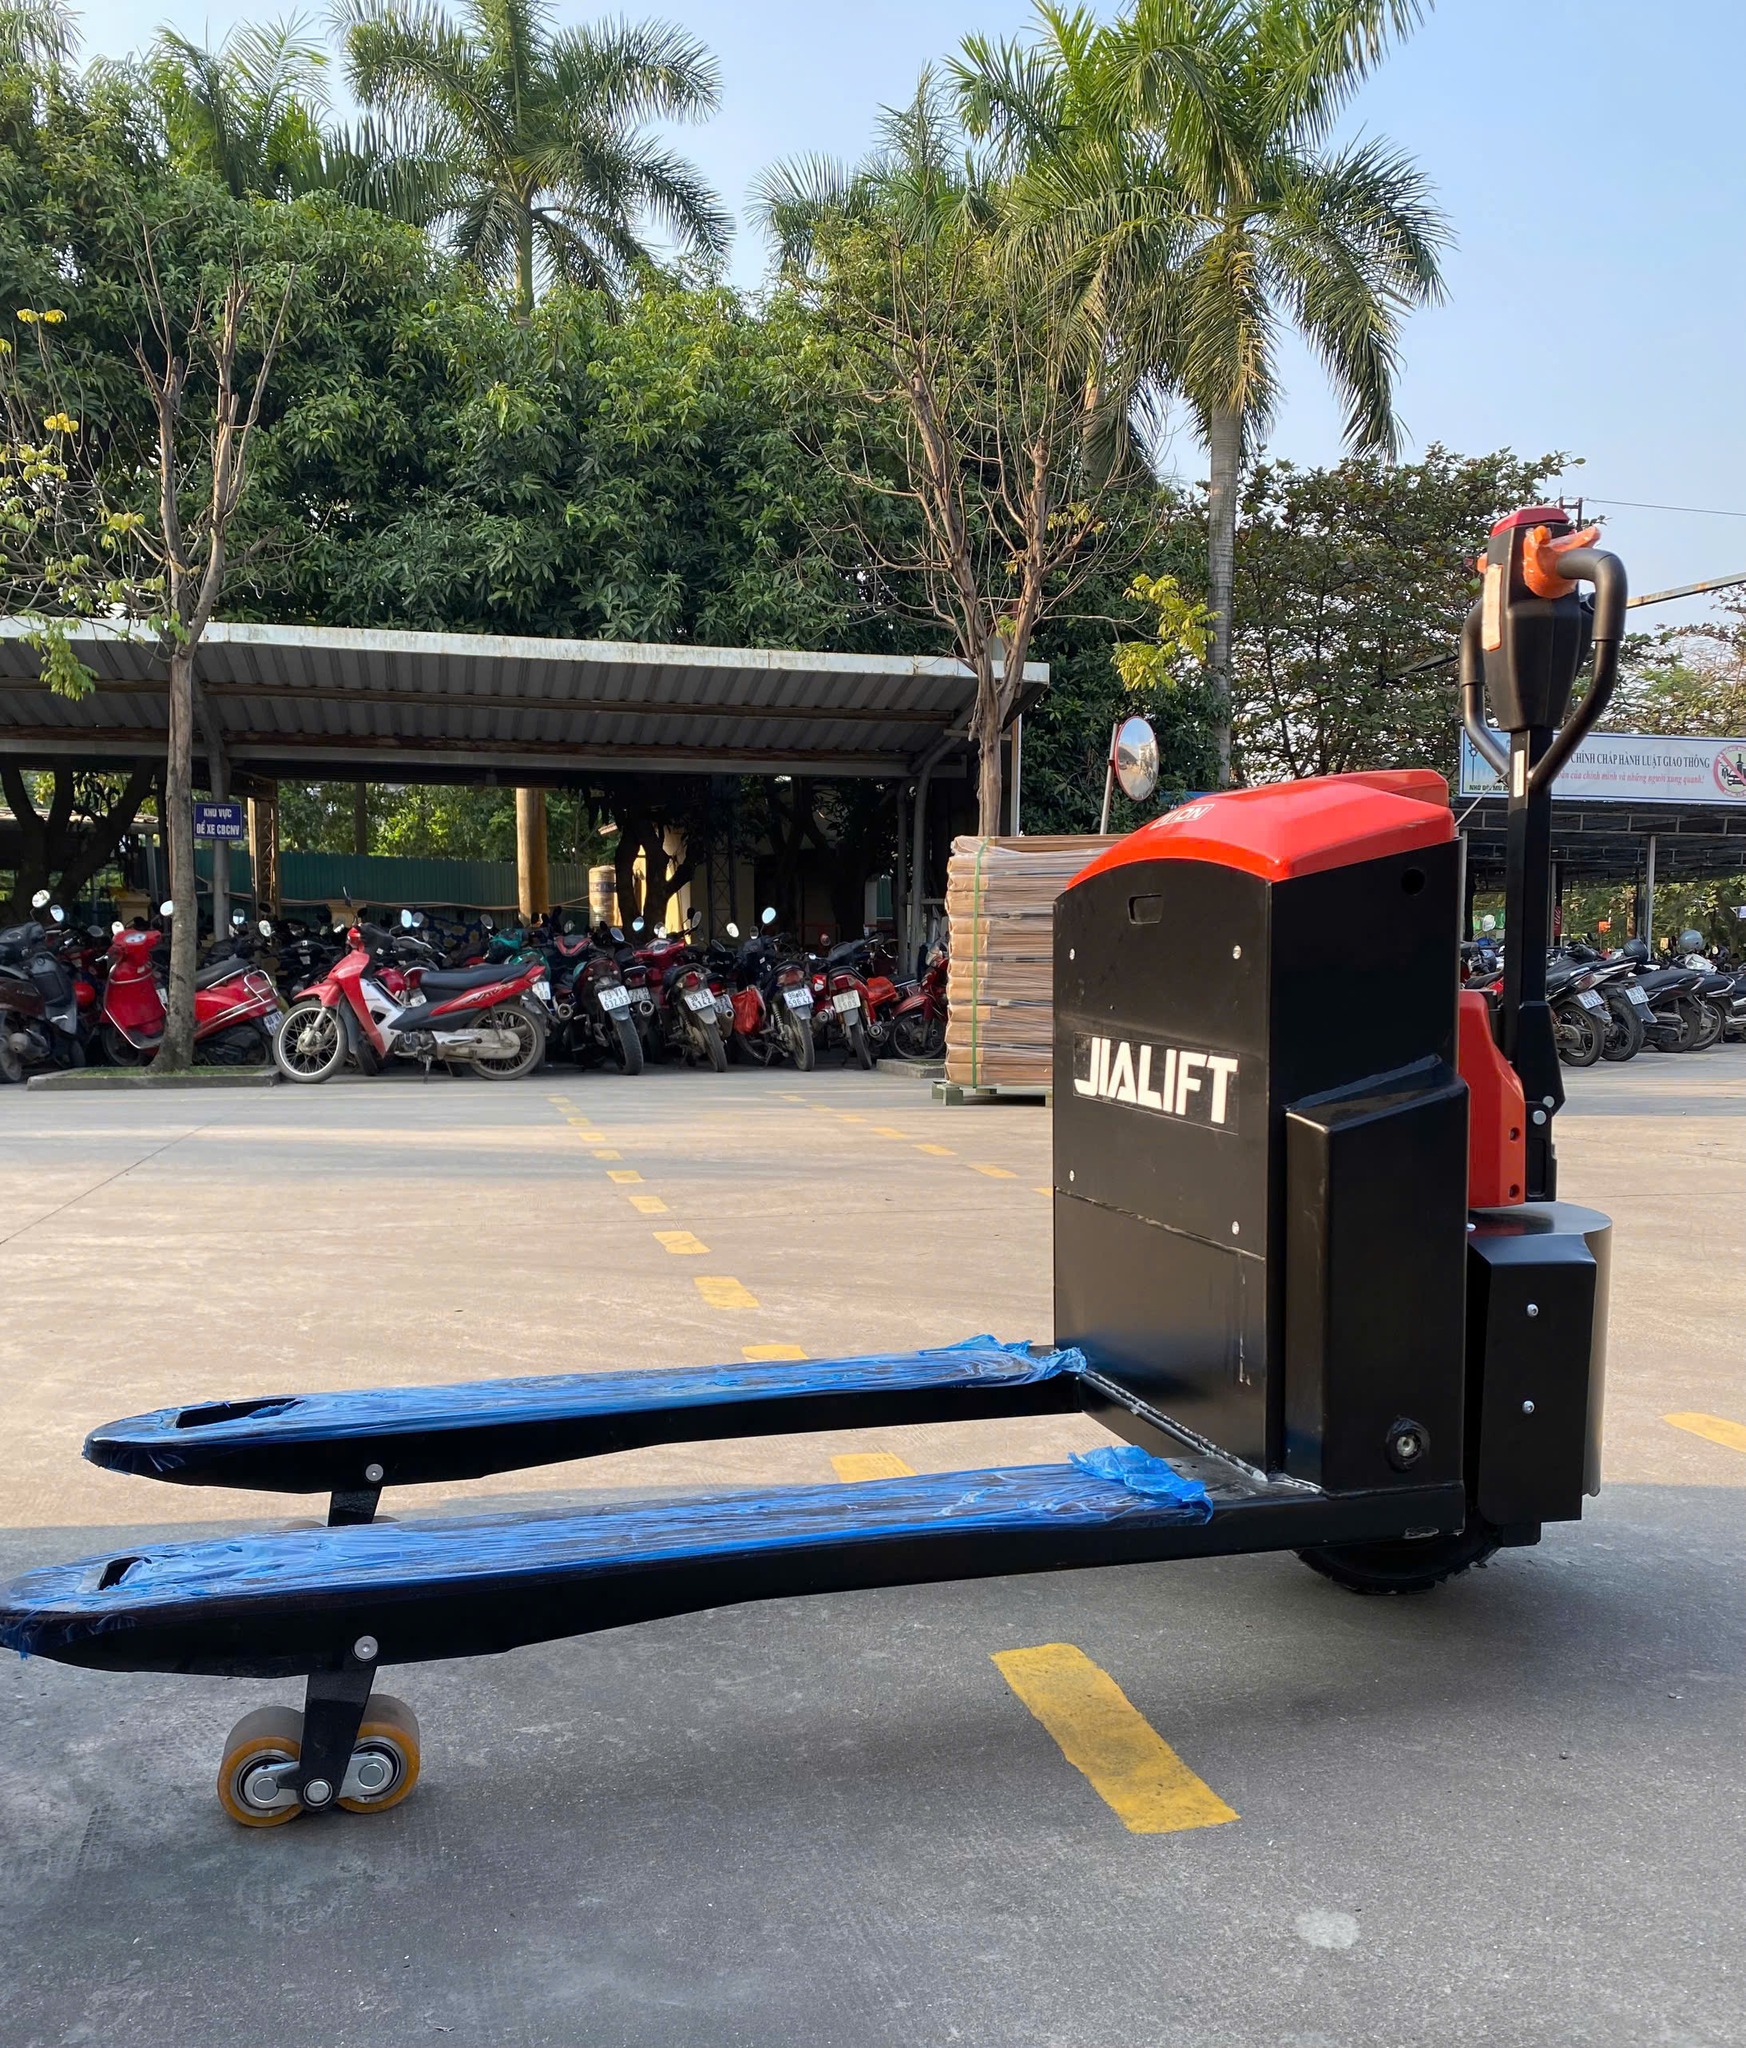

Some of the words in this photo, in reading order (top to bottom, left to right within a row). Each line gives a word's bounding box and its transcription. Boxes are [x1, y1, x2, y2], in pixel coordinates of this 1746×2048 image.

[1663, 756, 1683, 768] GIAO
[203, 808, 217, 818] KHU
[206, 824, 216, 835] XE
[1074, 1037, 1239, 1124] JIALIFT
